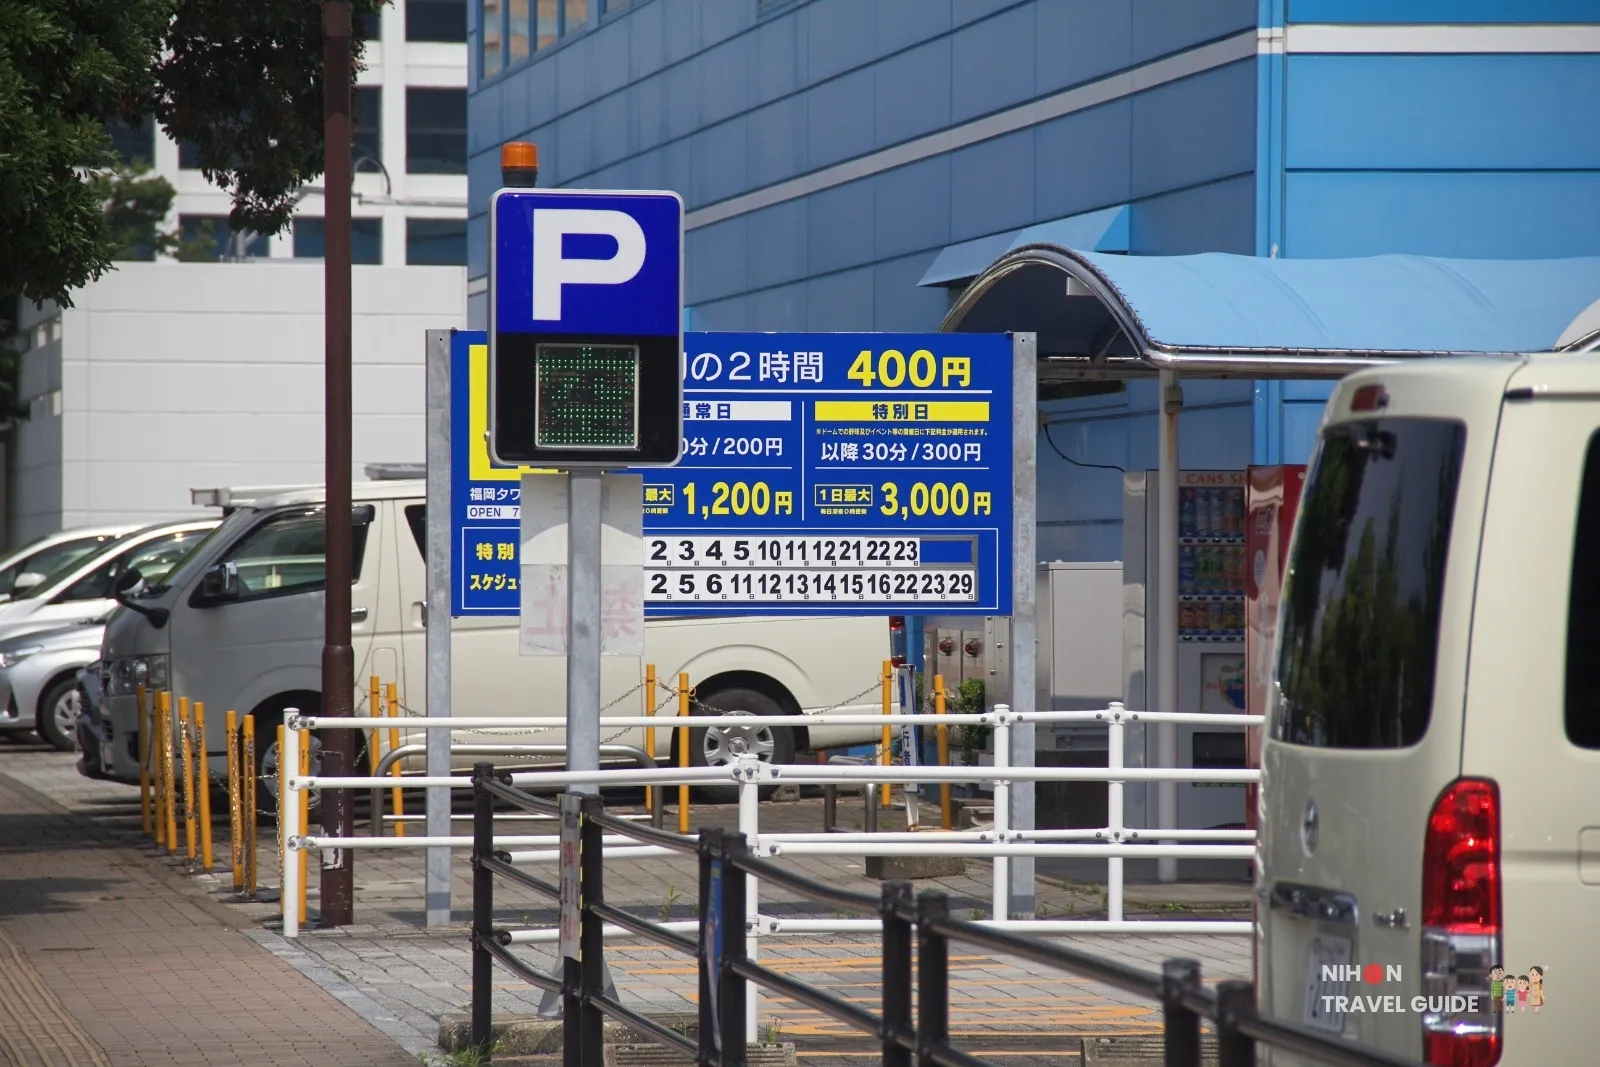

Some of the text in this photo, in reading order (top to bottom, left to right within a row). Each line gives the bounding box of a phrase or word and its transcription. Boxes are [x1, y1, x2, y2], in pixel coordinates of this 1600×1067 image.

[532, 208, 646, 321] P
[683, 349, 971, 388] の2時間 400円
[872, 403, 929, 420] 特別日
[1187, 473, 1224, 484] CANS
[682, 481, 793, 520] 1,200円
[819, 481, 991, 520] 1日最大 3,000円
[469, 507, 501, 517] OPEN
[476, 542, 515, 561] 特別
[469, 573, 520, 591] スケジュ
